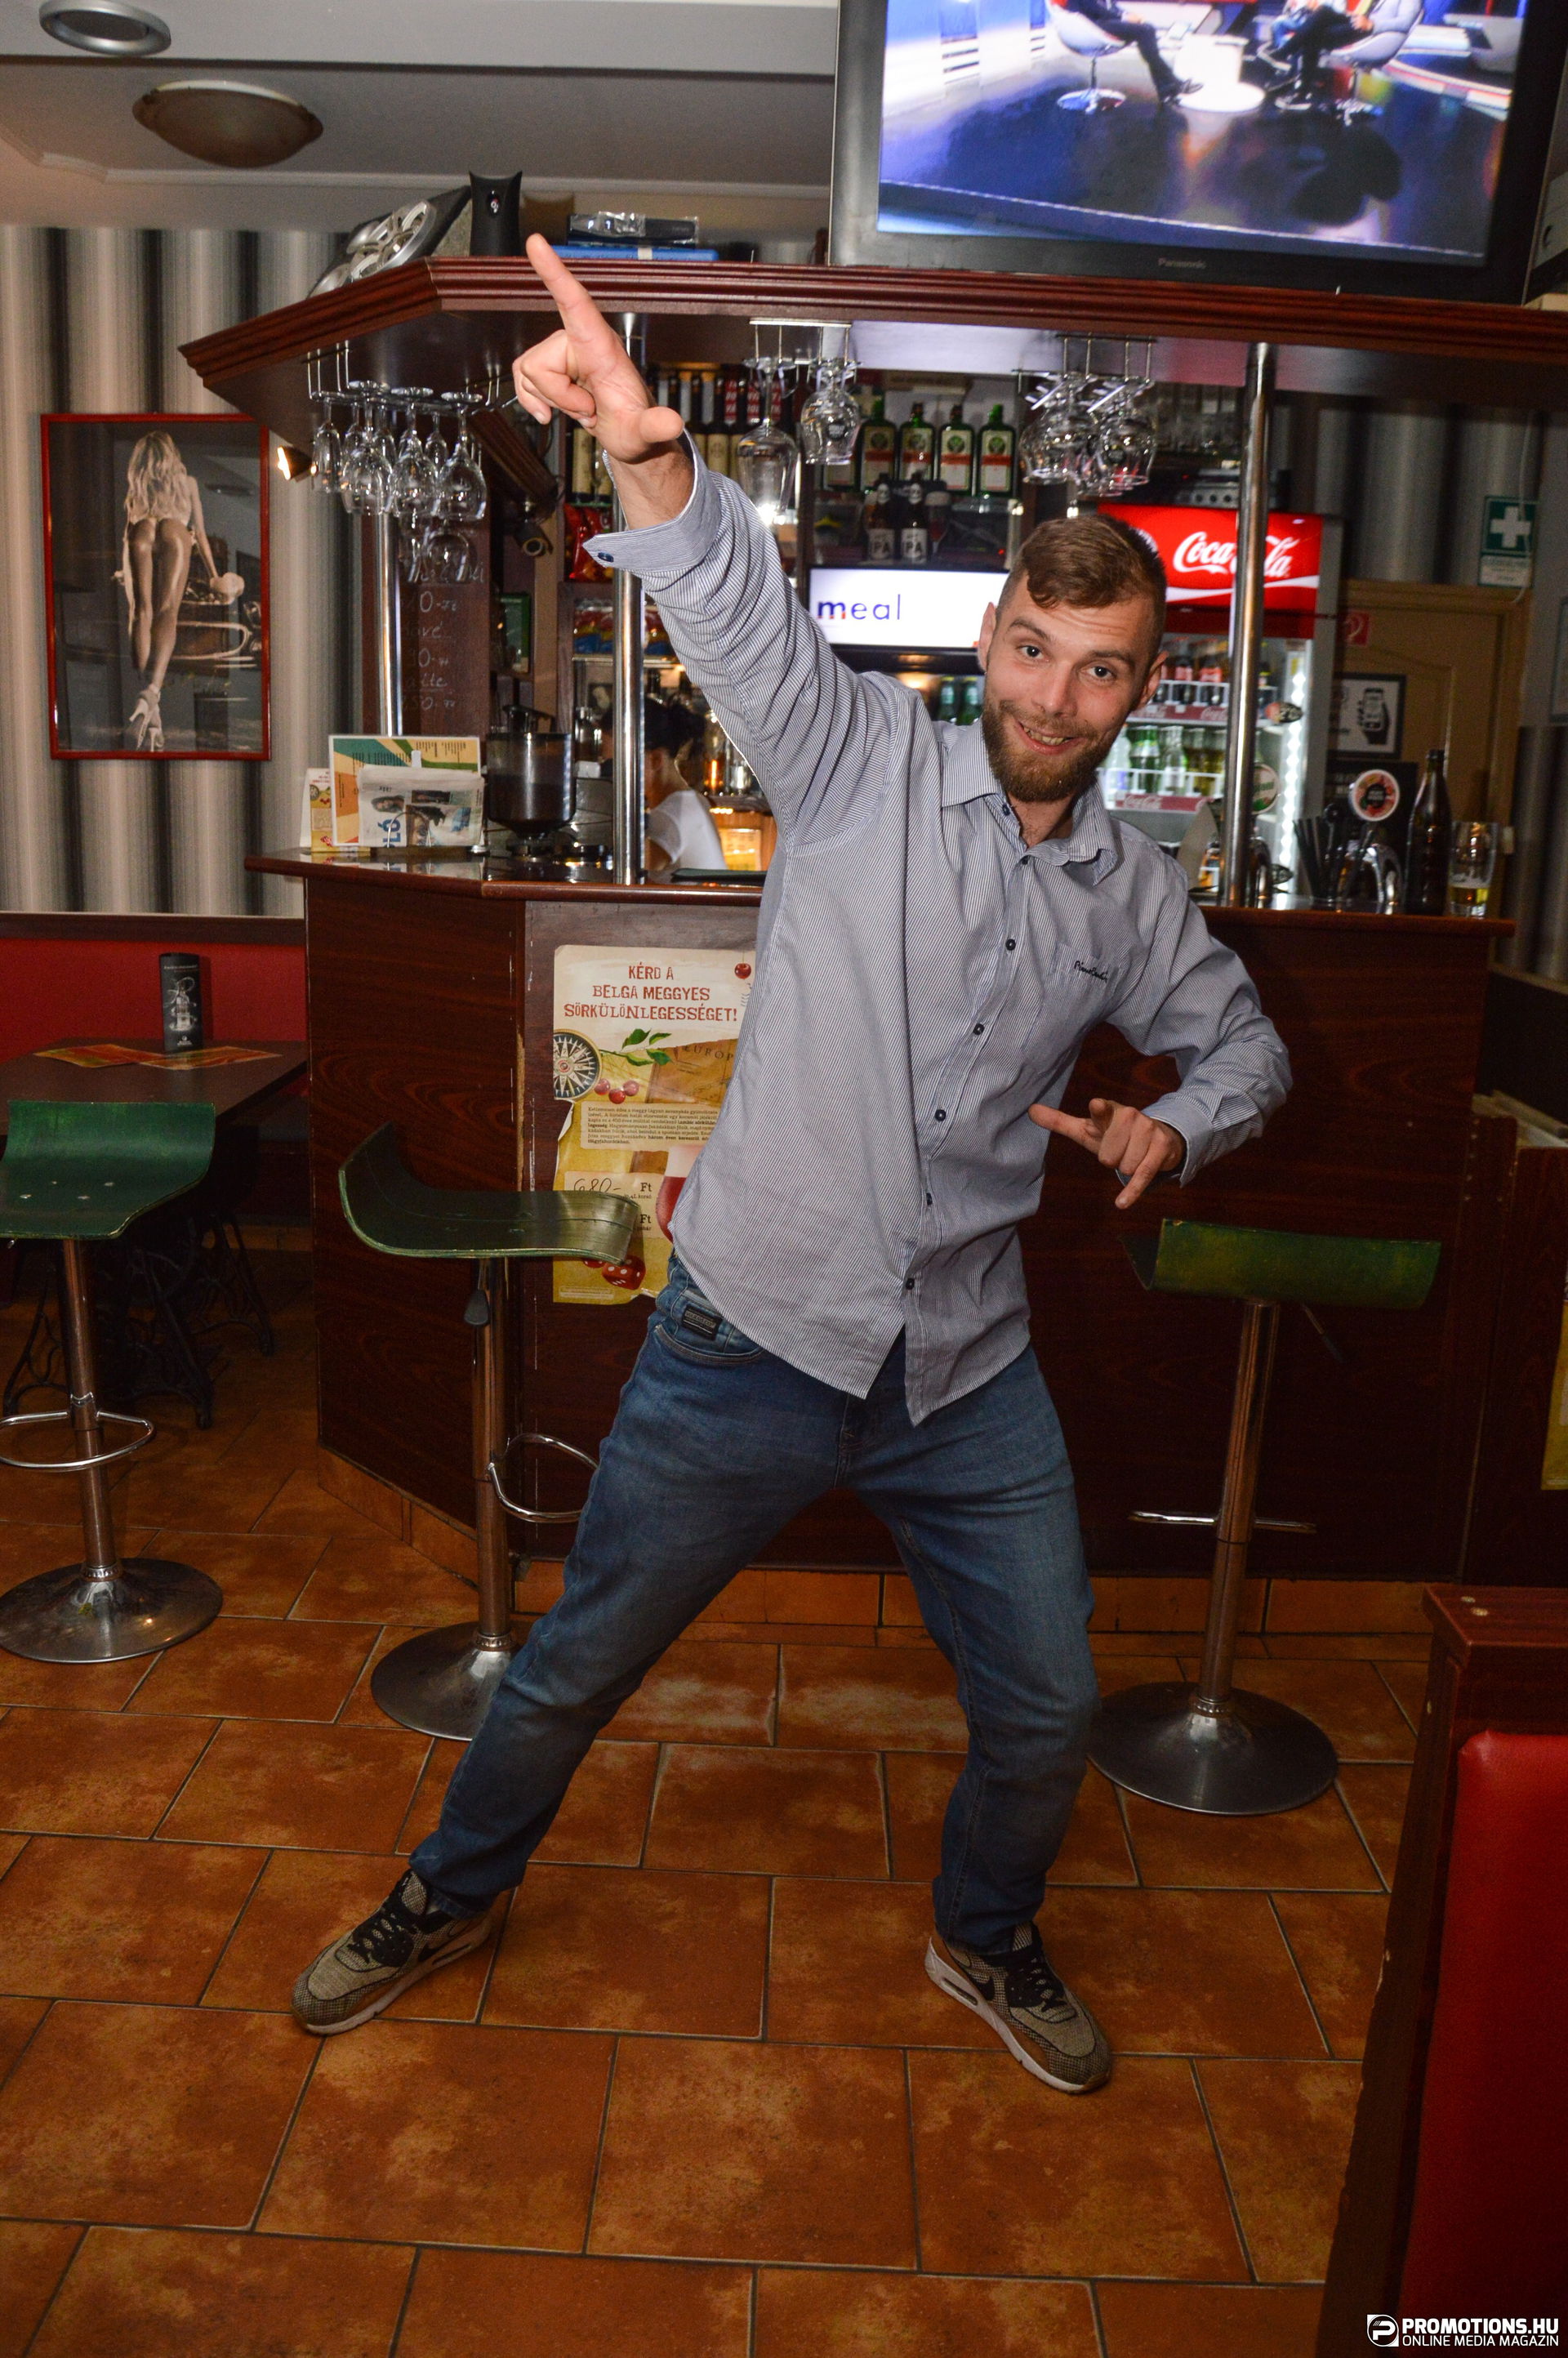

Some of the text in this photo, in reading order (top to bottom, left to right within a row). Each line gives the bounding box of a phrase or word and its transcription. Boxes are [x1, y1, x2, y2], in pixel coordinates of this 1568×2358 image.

[817, 594, 900, 620] meal
[377, 818, 401, 848] LÓ
[629, 962, 675, 980] KÉRD A
[593, 985, 710, 1001] BELGA MEGGYES
[564, 1002, 738, 1022] SÖRKÜLÖNLEGESSÉGET!
[683, 1045, 735, 1062] EUROP
[640, 1182, 652, 1192] Ft
[639, 1214, 652, 1224] Ft
